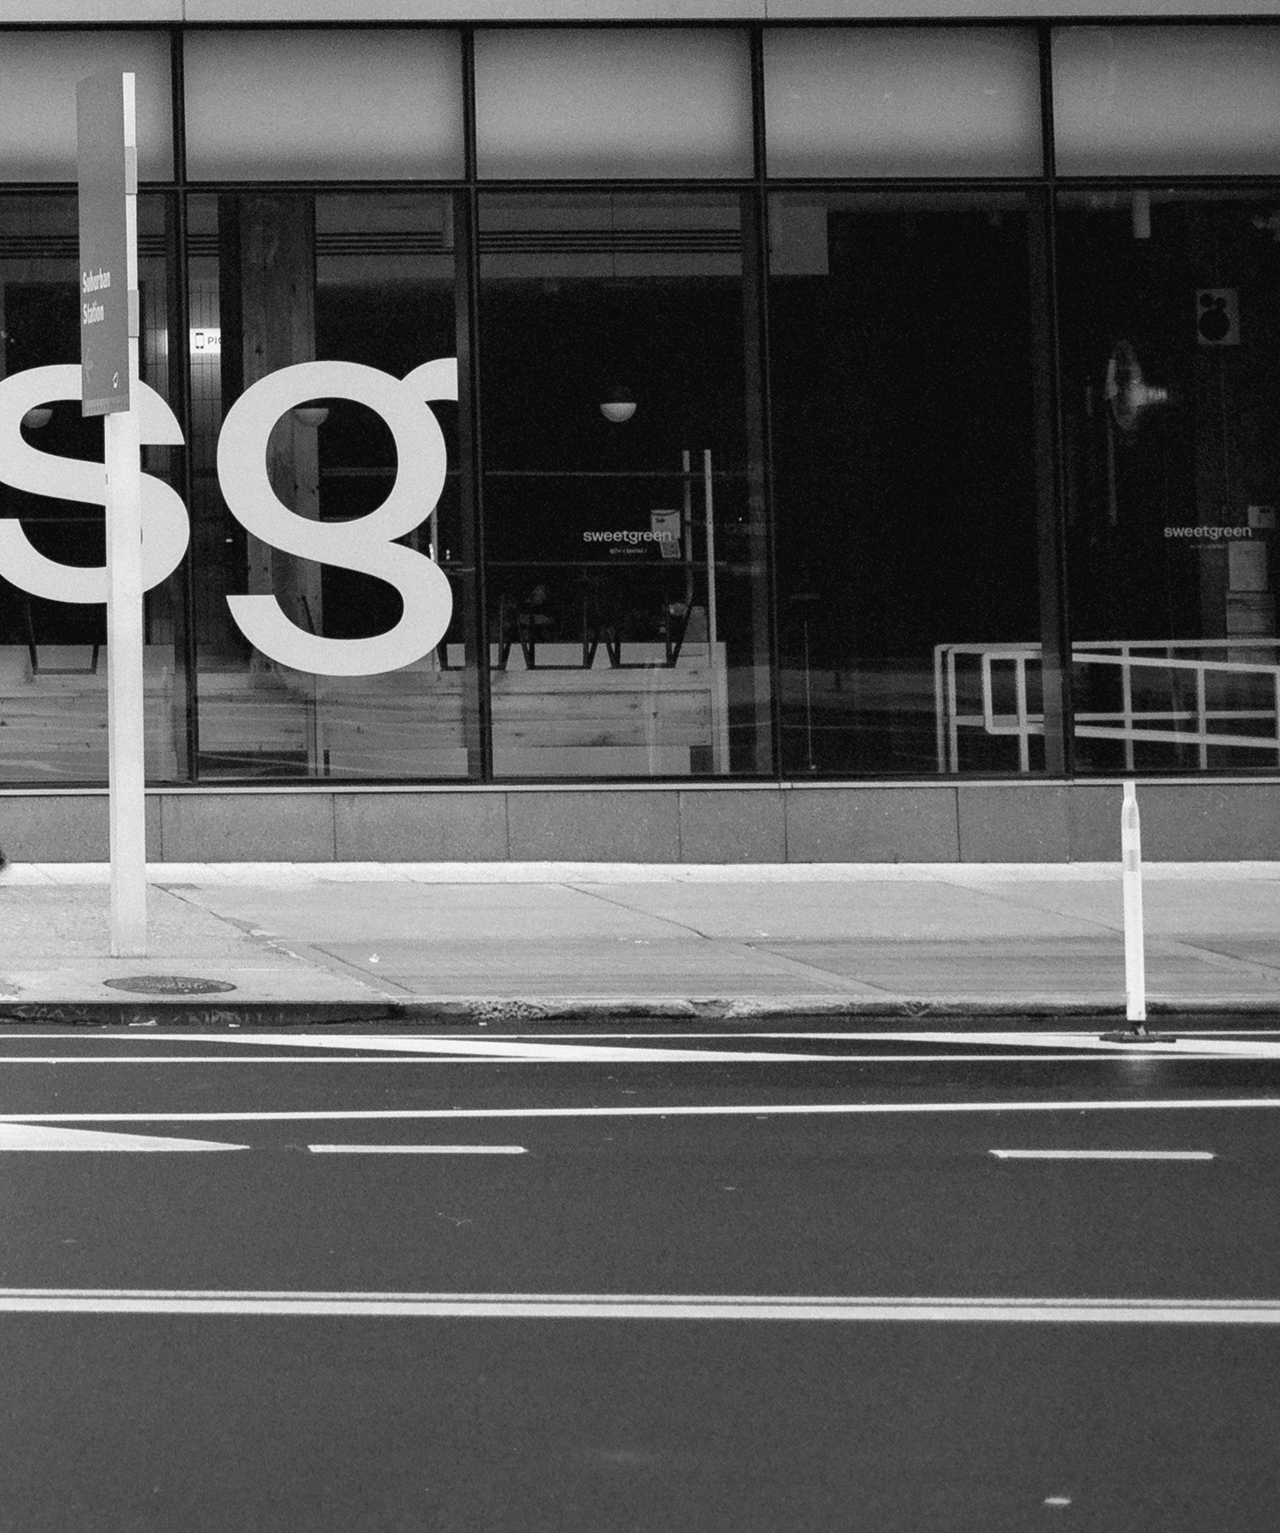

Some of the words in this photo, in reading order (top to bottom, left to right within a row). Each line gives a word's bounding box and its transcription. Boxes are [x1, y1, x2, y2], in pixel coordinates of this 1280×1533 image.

[82, 268, 111, 294] Suburban
[82, 300, 105, 325] Station
[583, 530, 672, 545] sweetgreen
[1164, 526, 1252, 540] sweetgreen
